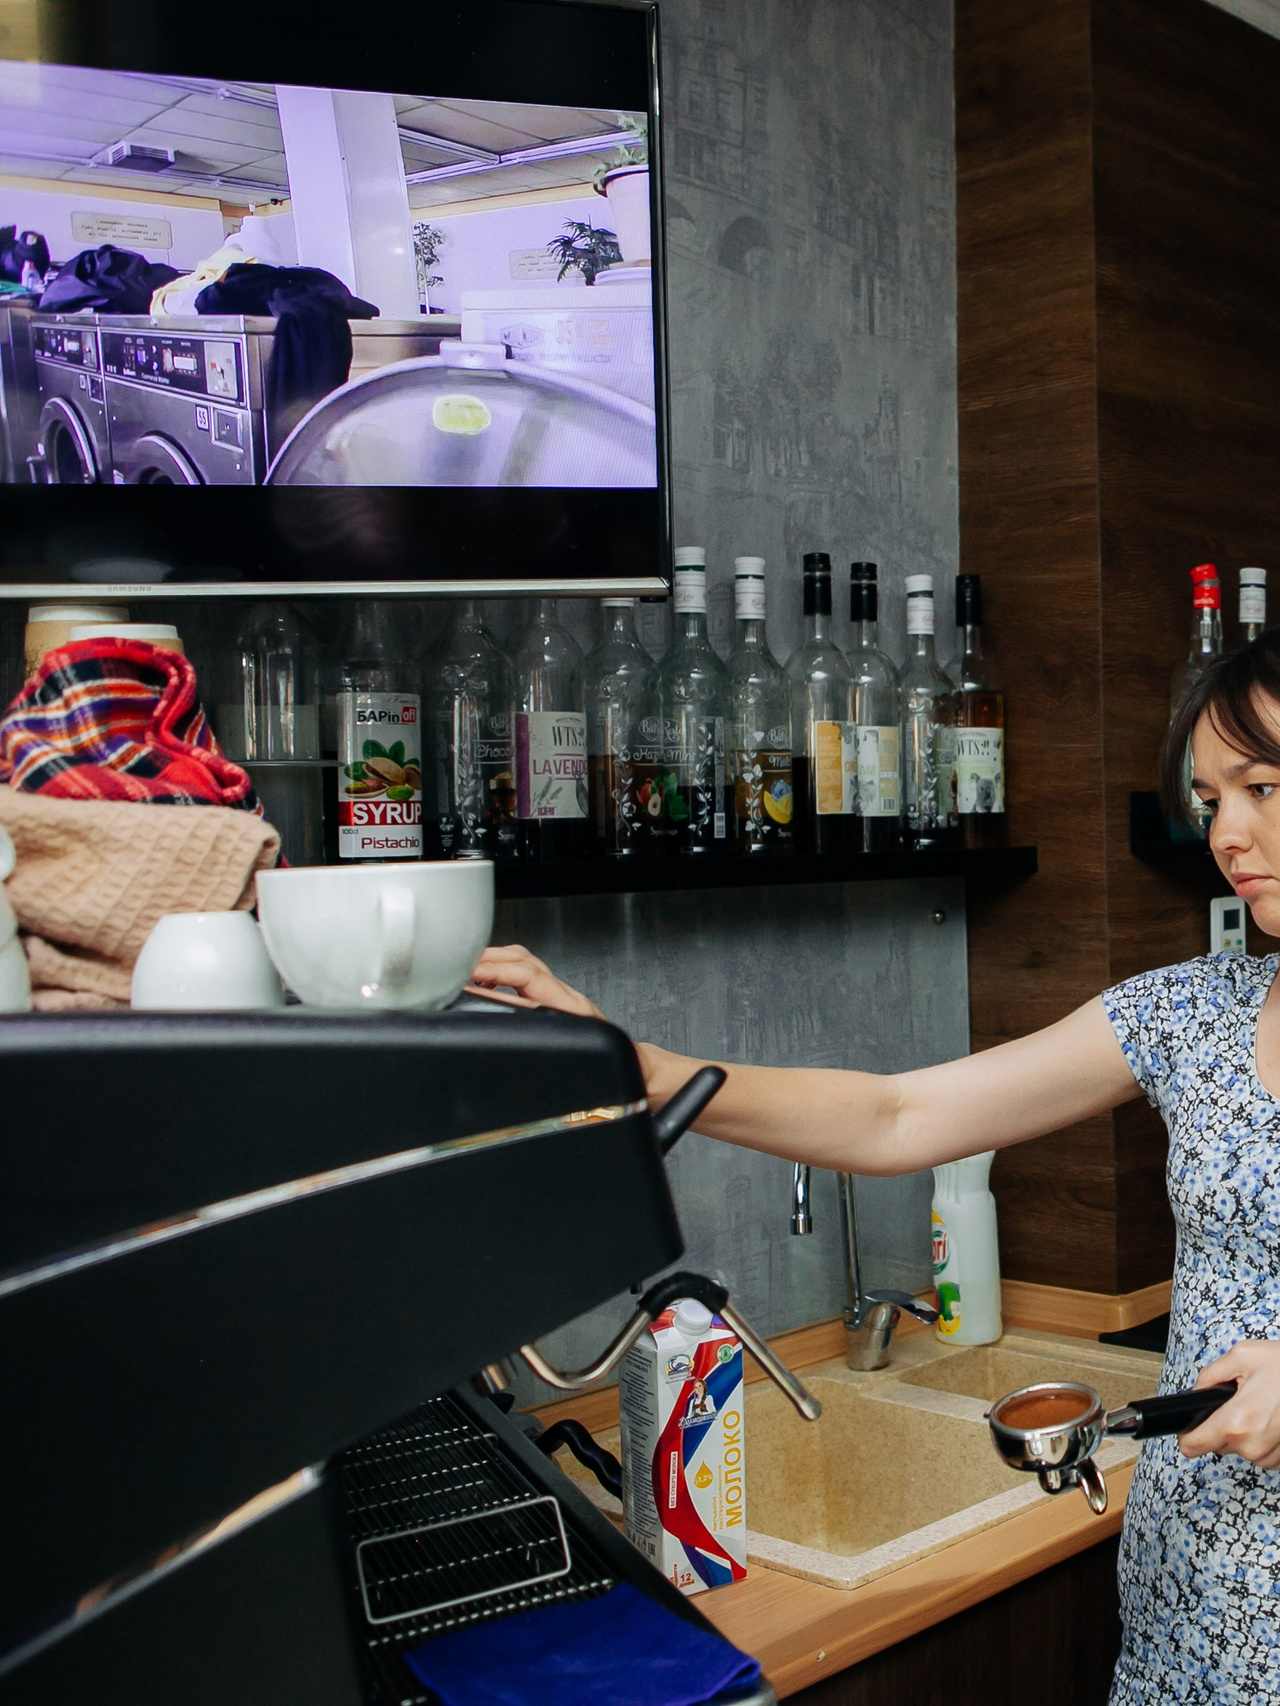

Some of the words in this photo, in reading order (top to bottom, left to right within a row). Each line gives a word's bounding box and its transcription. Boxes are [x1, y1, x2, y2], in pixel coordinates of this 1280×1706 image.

[533, 759, 588, 775] LAVENDE
[353, 803, 422, 825] SYRUP
[361, 837, 419, 849] Pistachio
[722, 1410, 743, 1528] МОЛОКО
[680, 1572, 692, 1582] 12
